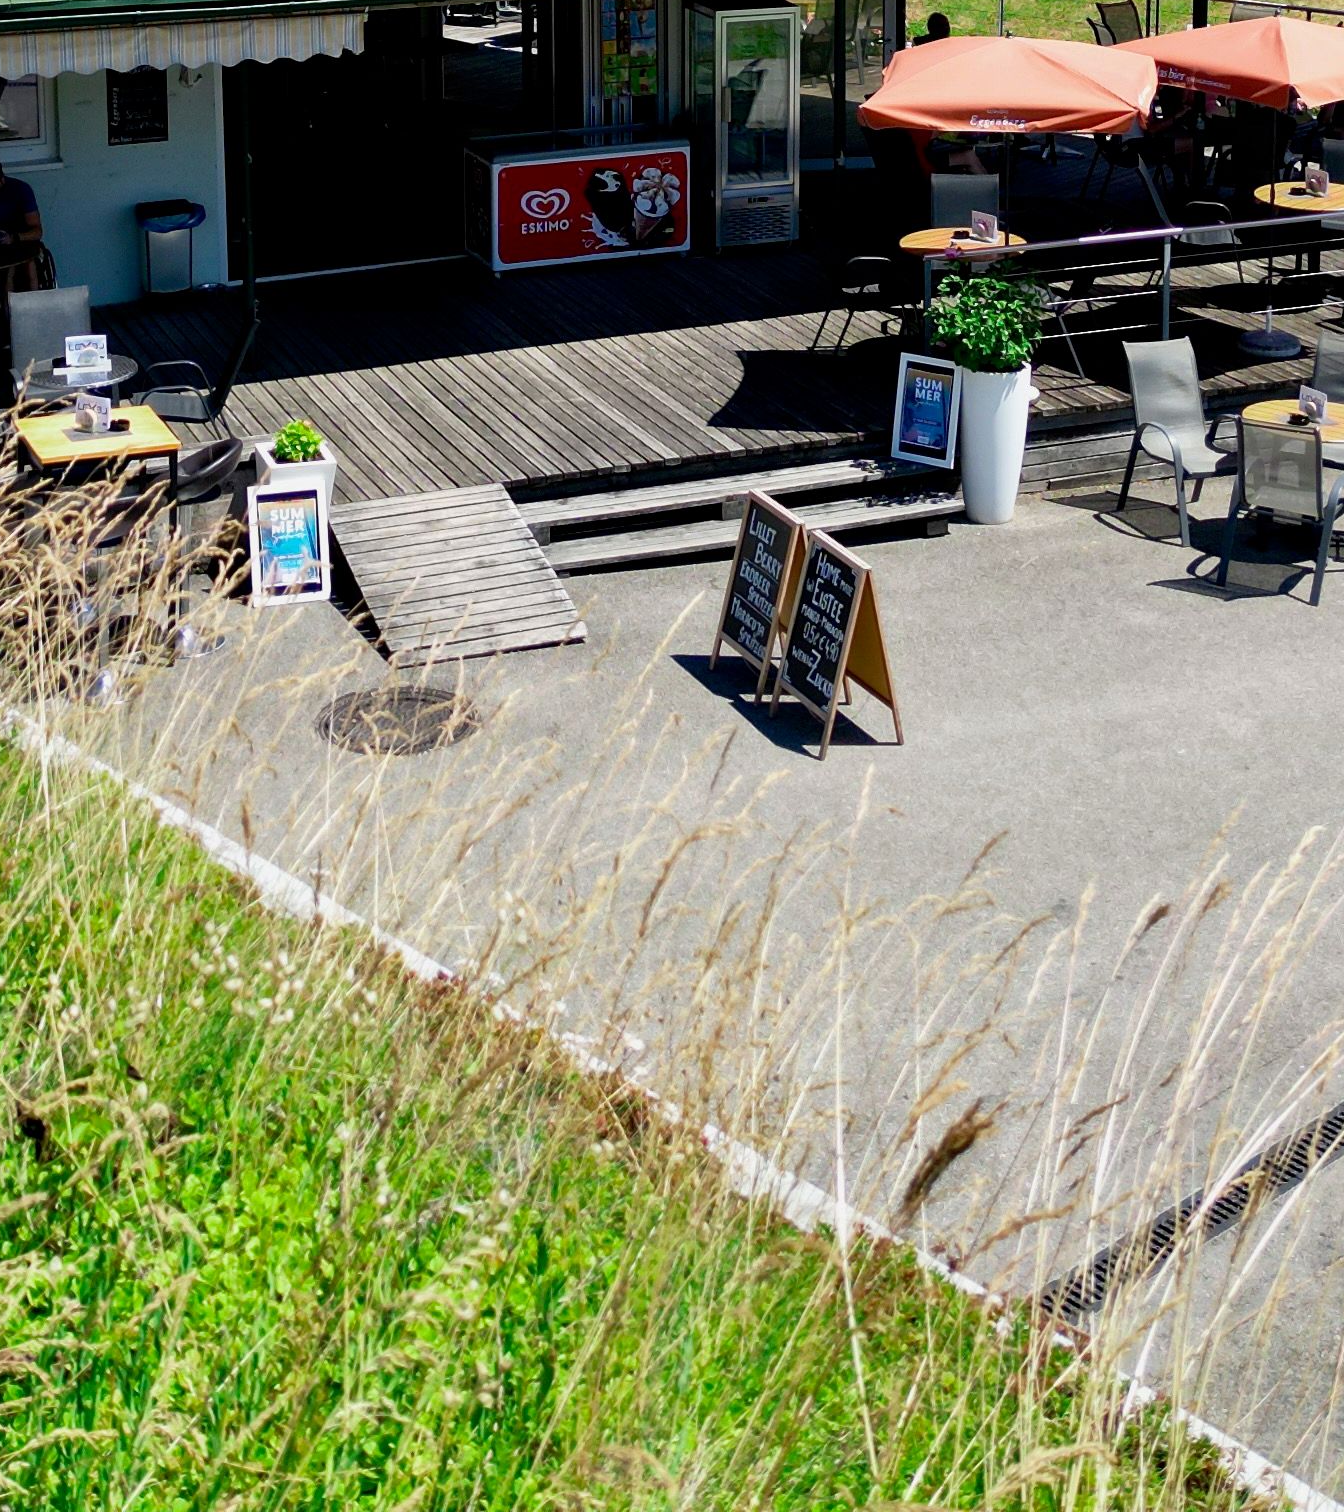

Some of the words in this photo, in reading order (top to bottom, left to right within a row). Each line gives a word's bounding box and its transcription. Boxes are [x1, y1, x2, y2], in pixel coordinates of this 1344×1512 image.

[521, 219, 570, 235] ESKIMO
[915, 377, 942, 391] SUM
[915, 388, 941, 402] MER
[270, 507, 305, 521] SUM
[271, 519, 305, 534] MER
[754, 544, 783, 580] BERRY
